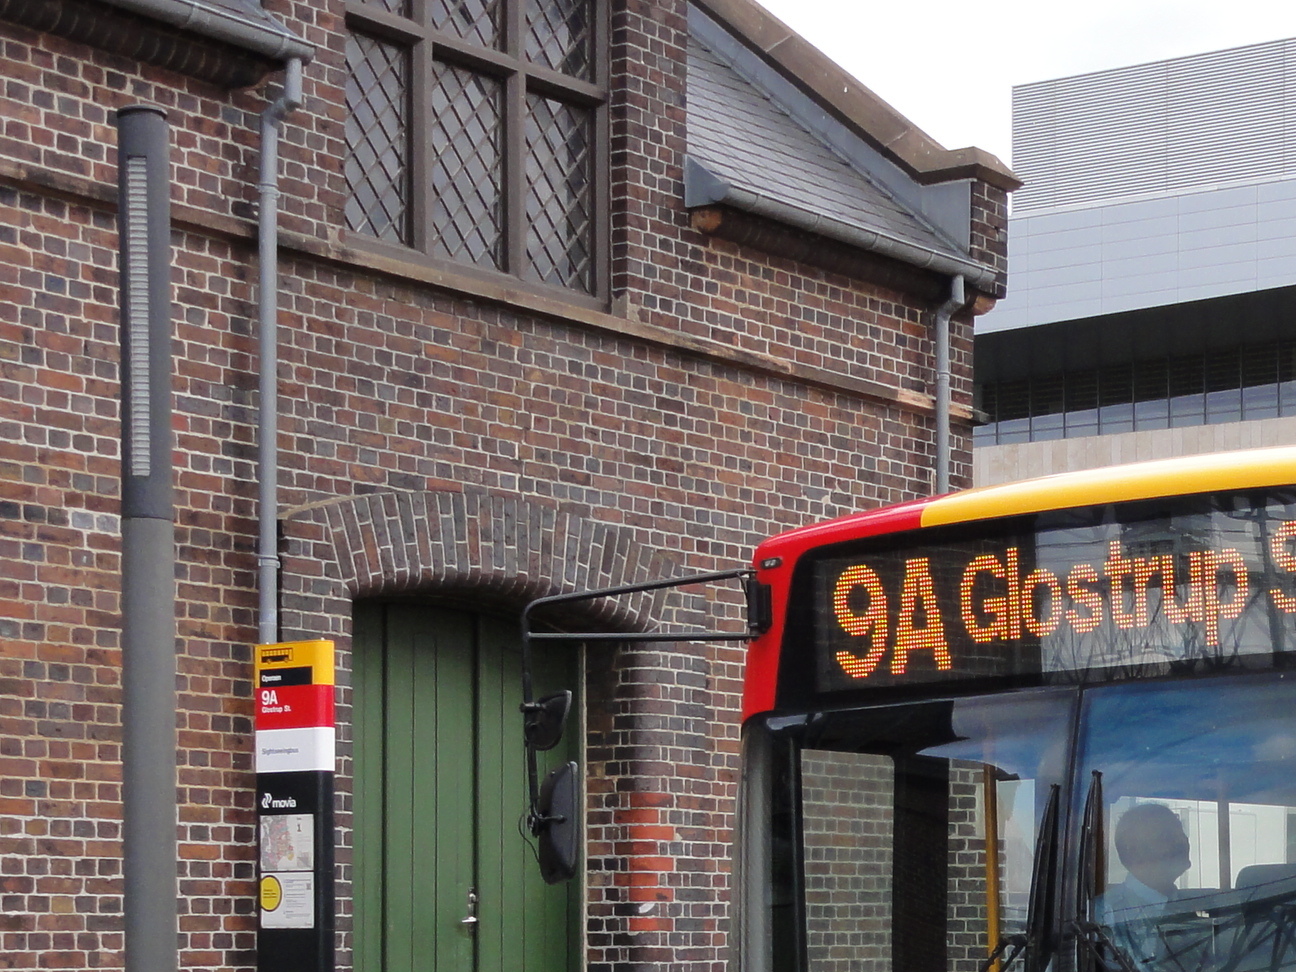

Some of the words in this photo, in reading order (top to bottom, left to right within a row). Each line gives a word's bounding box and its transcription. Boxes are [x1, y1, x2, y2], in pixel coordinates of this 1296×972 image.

[833, 557, 952, 679] 9A
[960, 540, 1249, 646] Glostrup
[261, 690, 278, 705] 9A
[272, 796, 297, 808] movia
